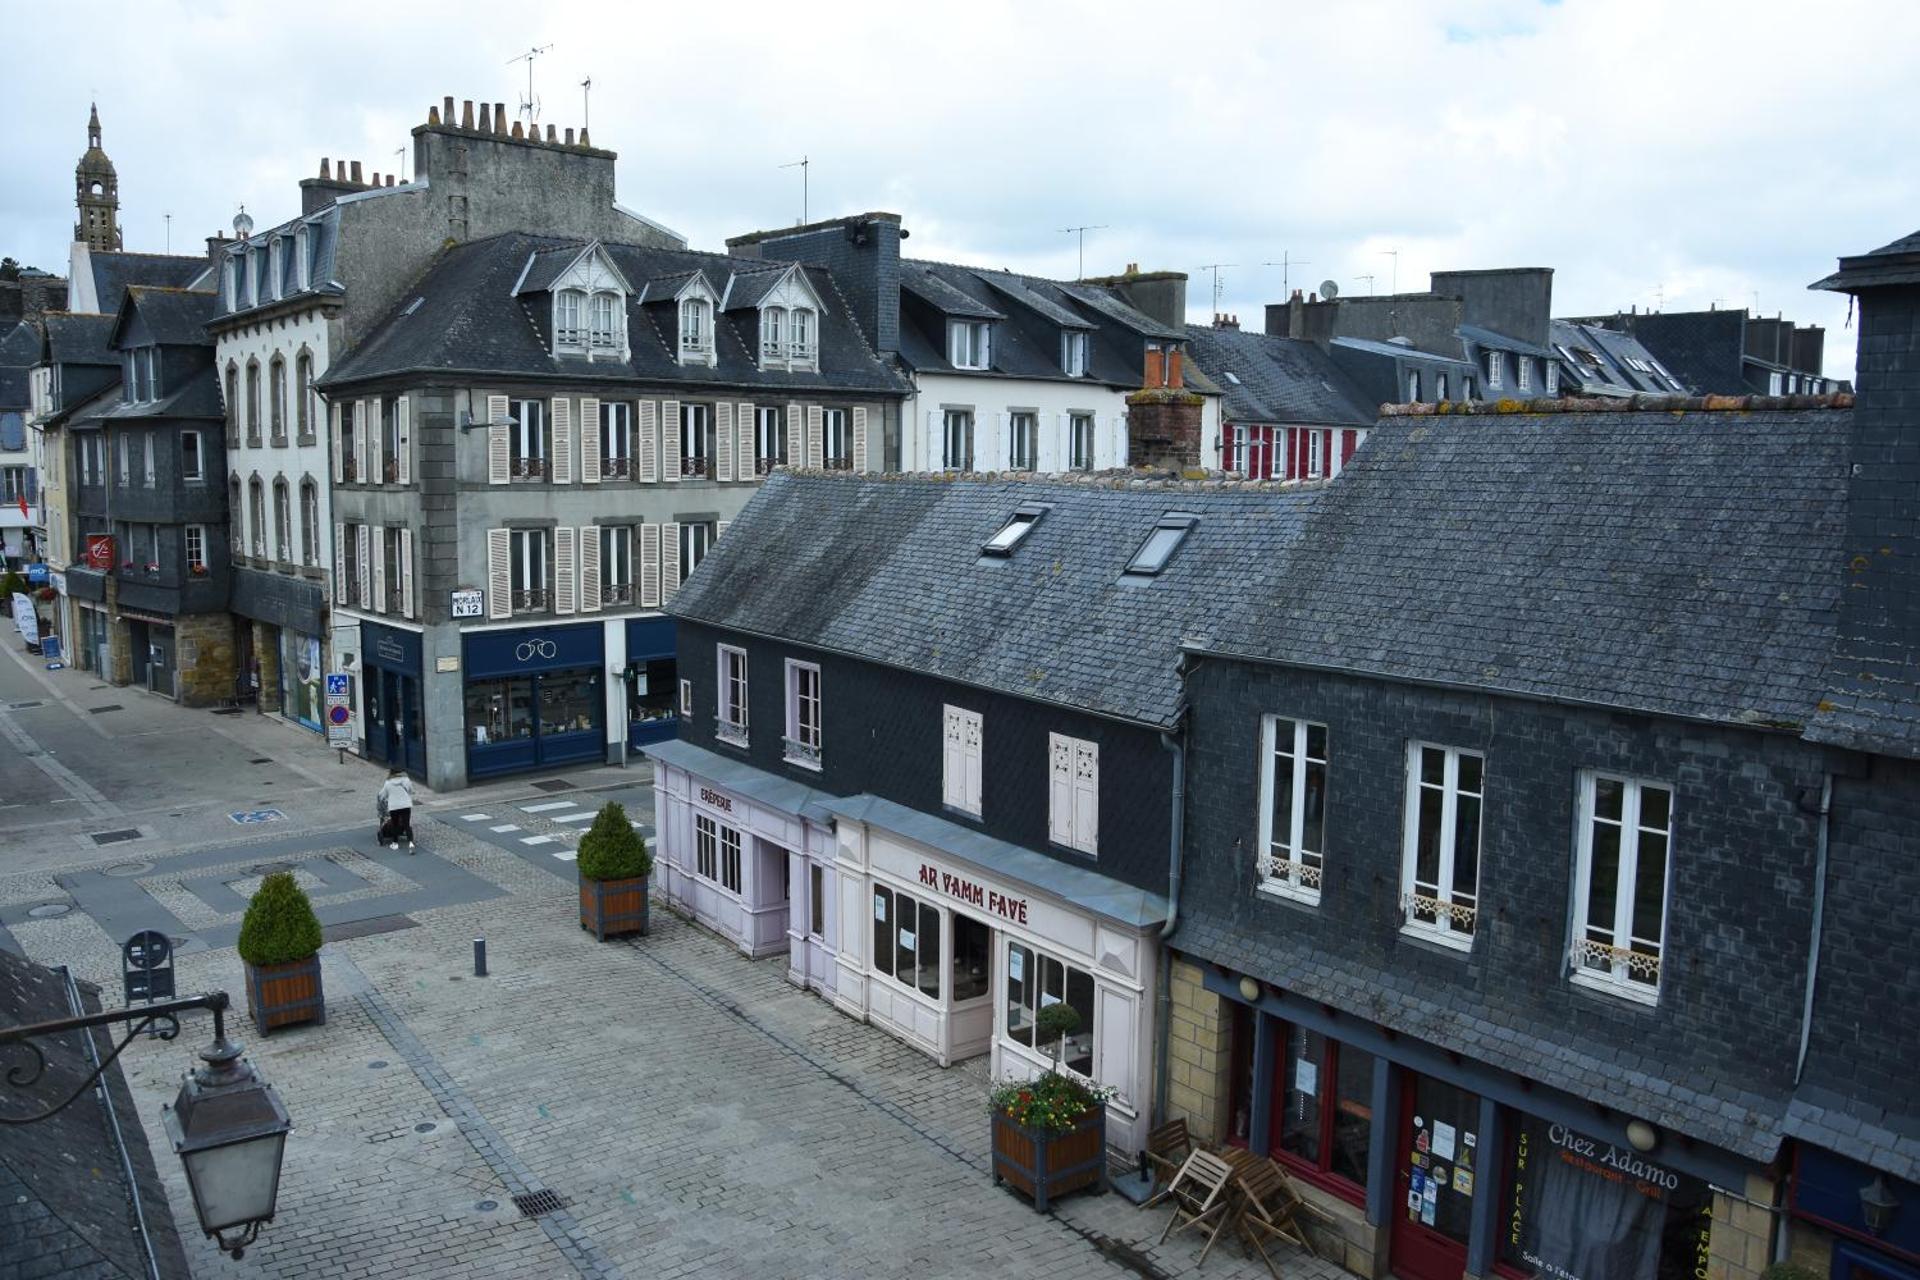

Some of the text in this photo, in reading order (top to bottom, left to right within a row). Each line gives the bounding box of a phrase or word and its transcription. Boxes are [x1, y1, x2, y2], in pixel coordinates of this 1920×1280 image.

[456, 604, 479, 615] N 12
[919, 864, 1028, 925] AR VAMM FAVÉ
[1549, 1124, 1678, 1189] Chez Adamo
[1512, 1133, 1527, 1244] SUR PLACE
[1522, 1250, 1544, 1268] Salle
